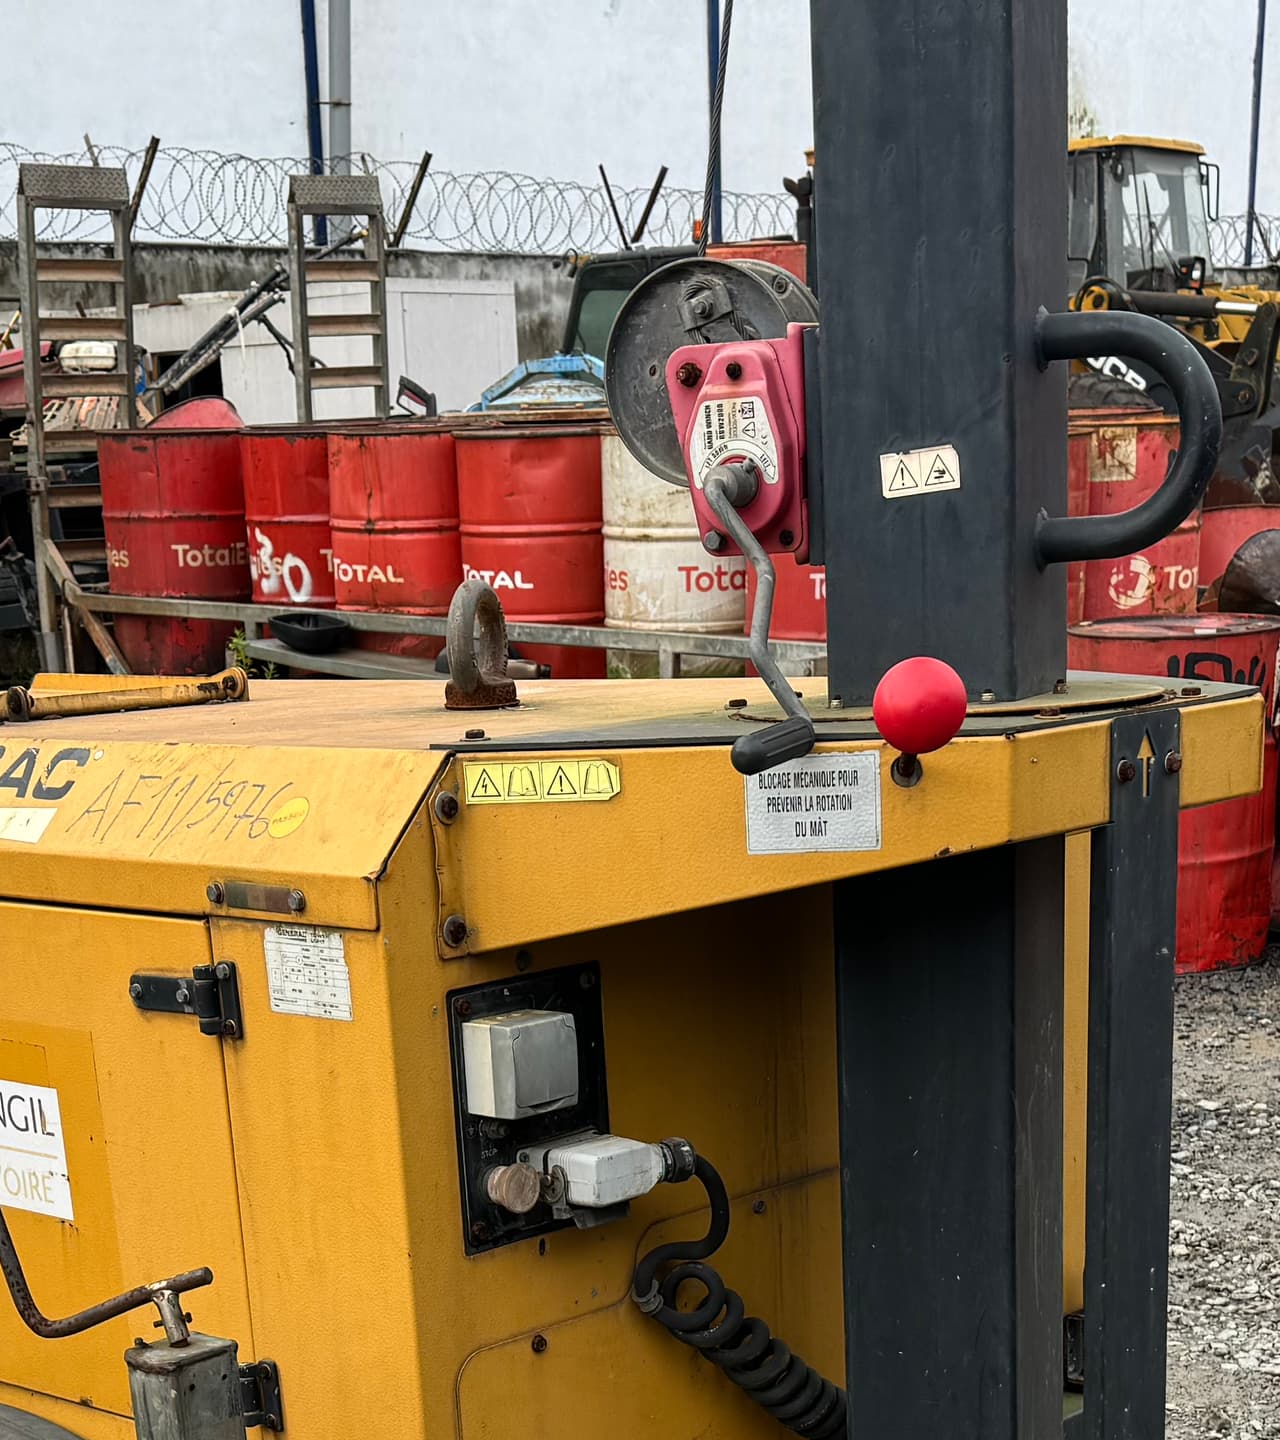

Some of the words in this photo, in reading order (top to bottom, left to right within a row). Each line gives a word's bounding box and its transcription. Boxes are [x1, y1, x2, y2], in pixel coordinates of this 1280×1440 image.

[758, 771, 792, 790] BLOCAGE
[793, 767, 836, 788] MÉCANIQUE
[838, 769, 859, 787] POUR
[767, 793, 803, 813] PRÉVENIR
[805, 796, 814, 811] LA
[816, 794, 852, 812] ROTATION
[795, 821, 807, 837] DU
[810, 816, 828, 837] MÂT
